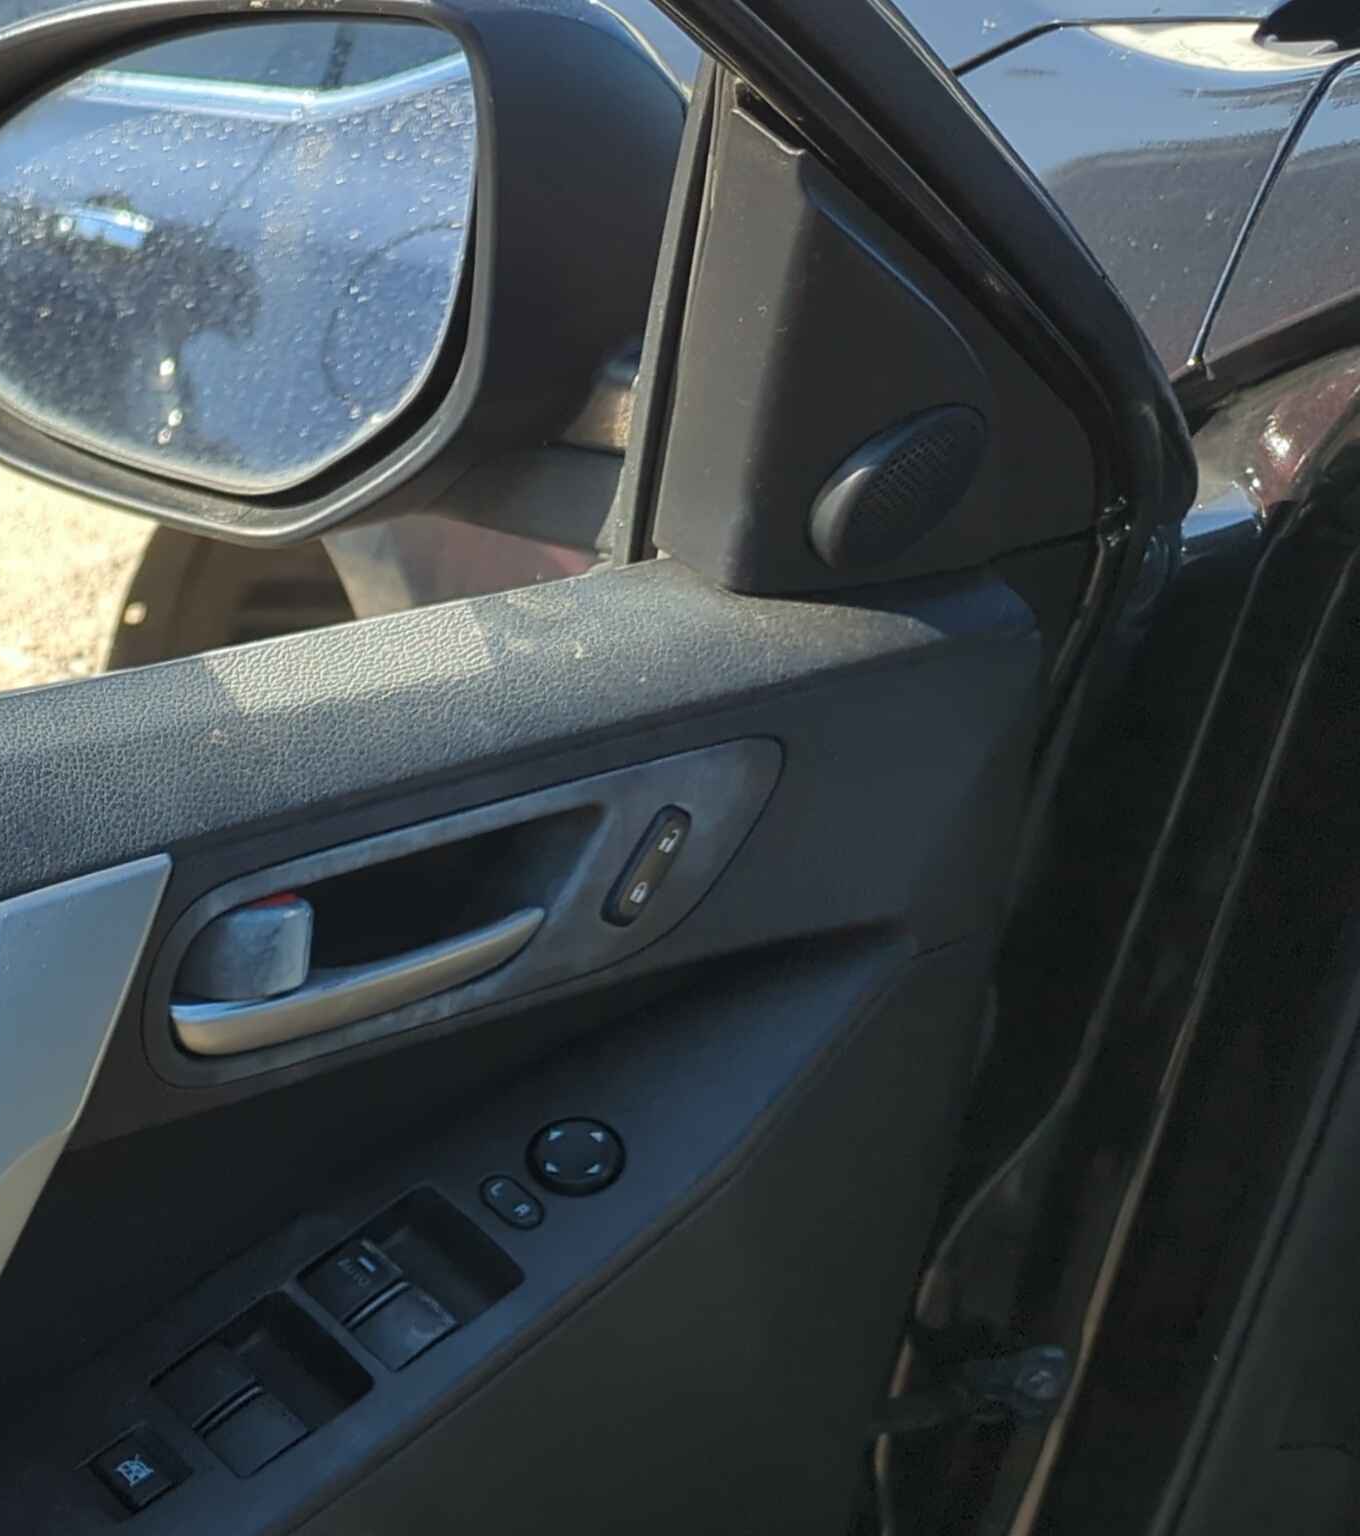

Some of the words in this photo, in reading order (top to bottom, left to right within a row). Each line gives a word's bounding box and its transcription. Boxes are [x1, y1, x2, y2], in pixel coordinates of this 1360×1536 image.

[489, 1181, 503, 1197] L
[513, 1202, 530, 1217] R
[336, 1258, 372, 1288] AUTO
